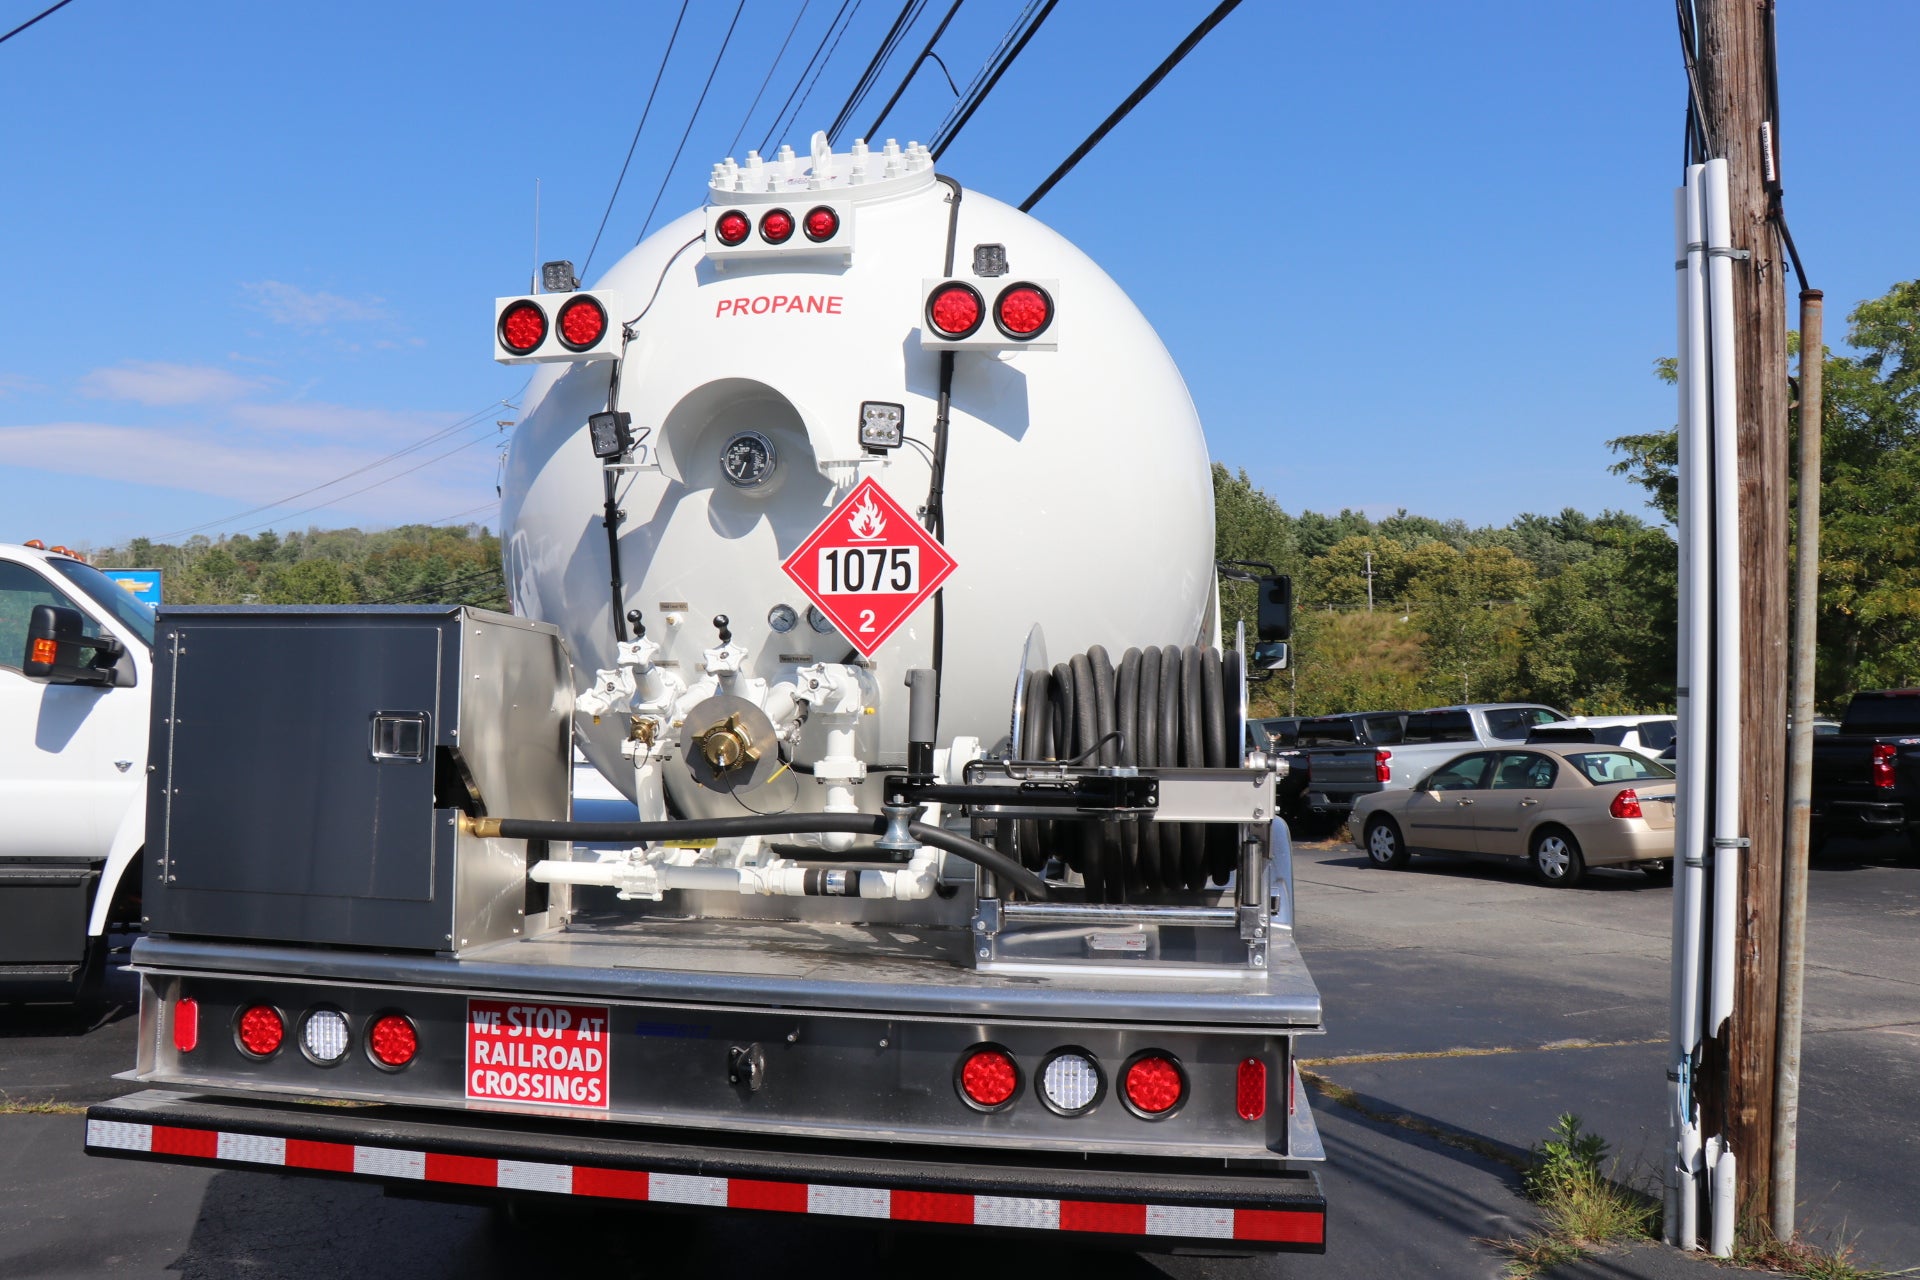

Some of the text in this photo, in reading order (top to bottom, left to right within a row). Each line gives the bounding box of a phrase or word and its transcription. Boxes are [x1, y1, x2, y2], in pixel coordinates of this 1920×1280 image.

[716, 295, 844, 318] PROPANE
[826, 548, 912, 592] 1075
[859, 609, 876, 633] 2
[472, 1006, 604, 1042] WE STOP AT
[475, 1040, 603, 1072] RAILROAD
[471, 1069, 602, 1103] CROSSINGS
